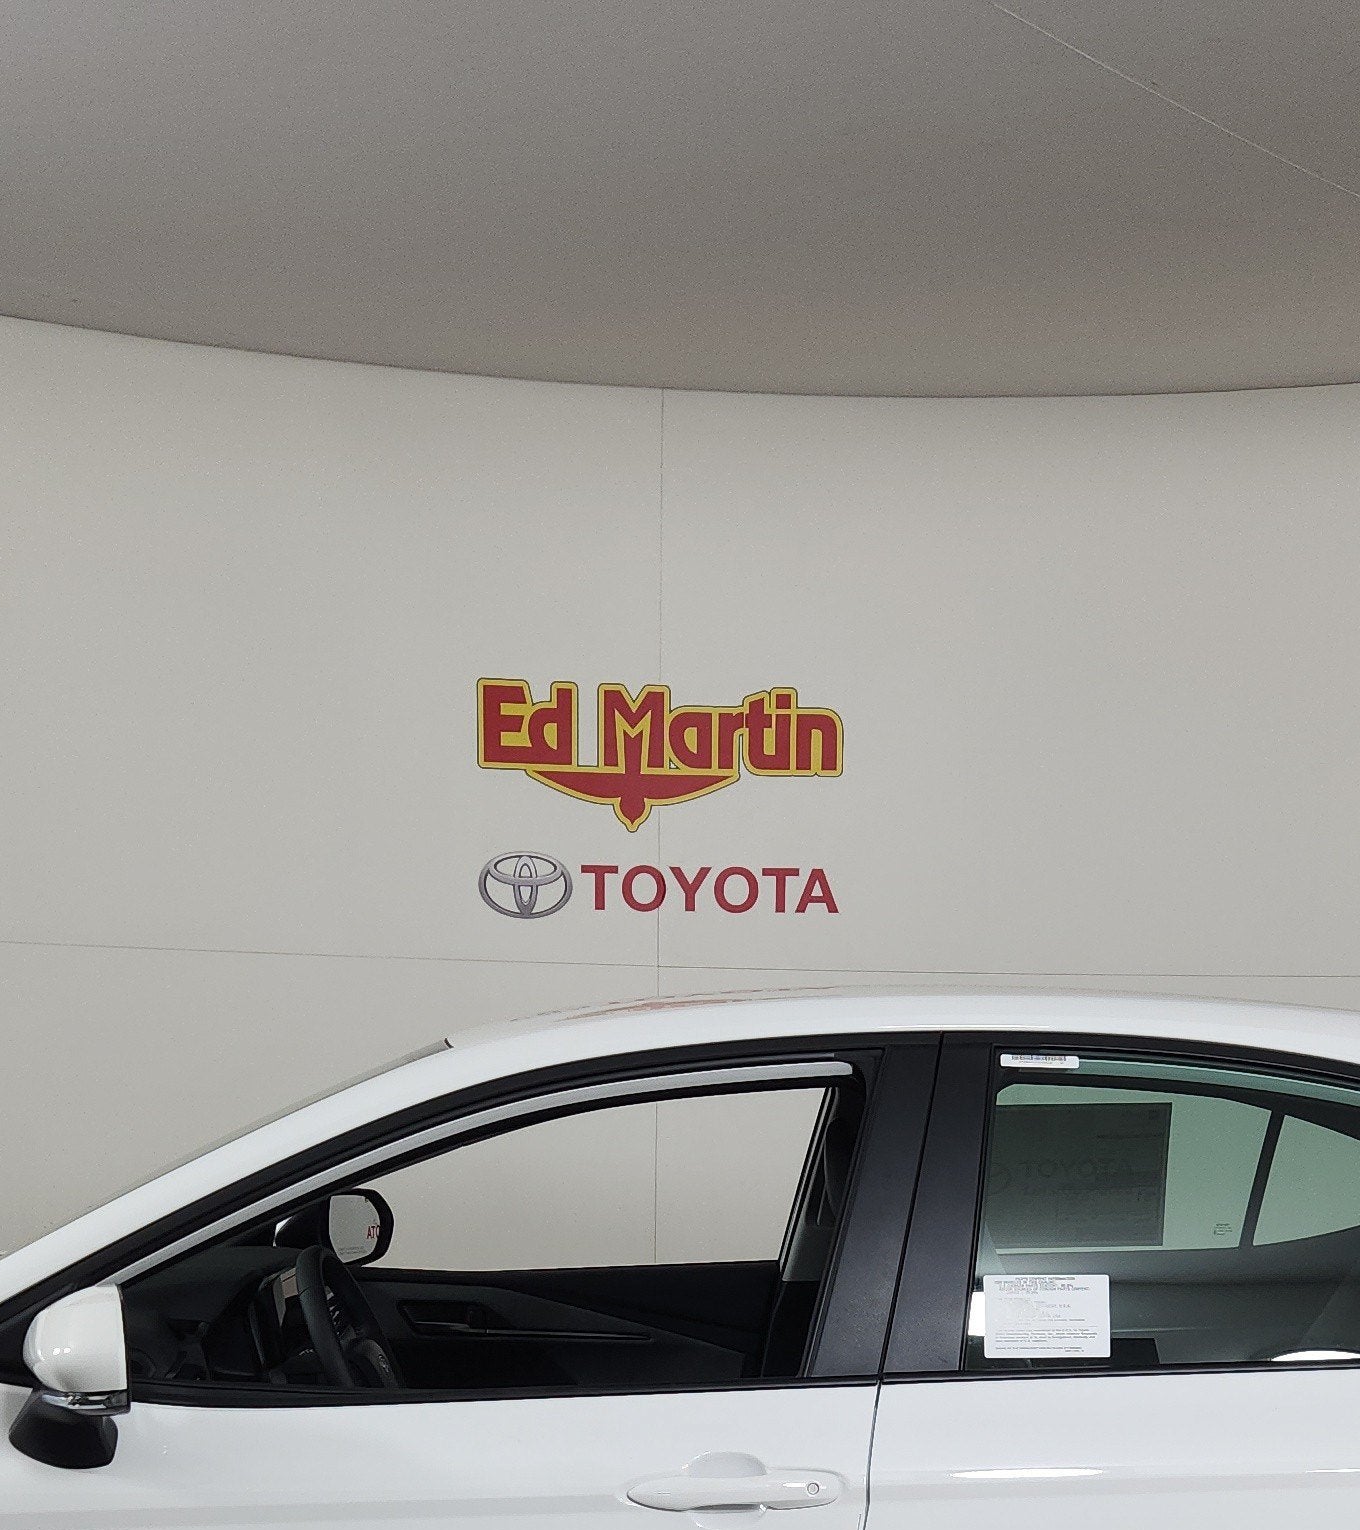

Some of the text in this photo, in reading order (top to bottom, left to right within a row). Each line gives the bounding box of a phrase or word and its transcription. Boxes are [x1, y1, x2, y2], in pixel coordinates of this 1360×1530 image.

[477, 678, 844, 777] Ed Martin
[581, 865, 839, 914] TOYOTA
